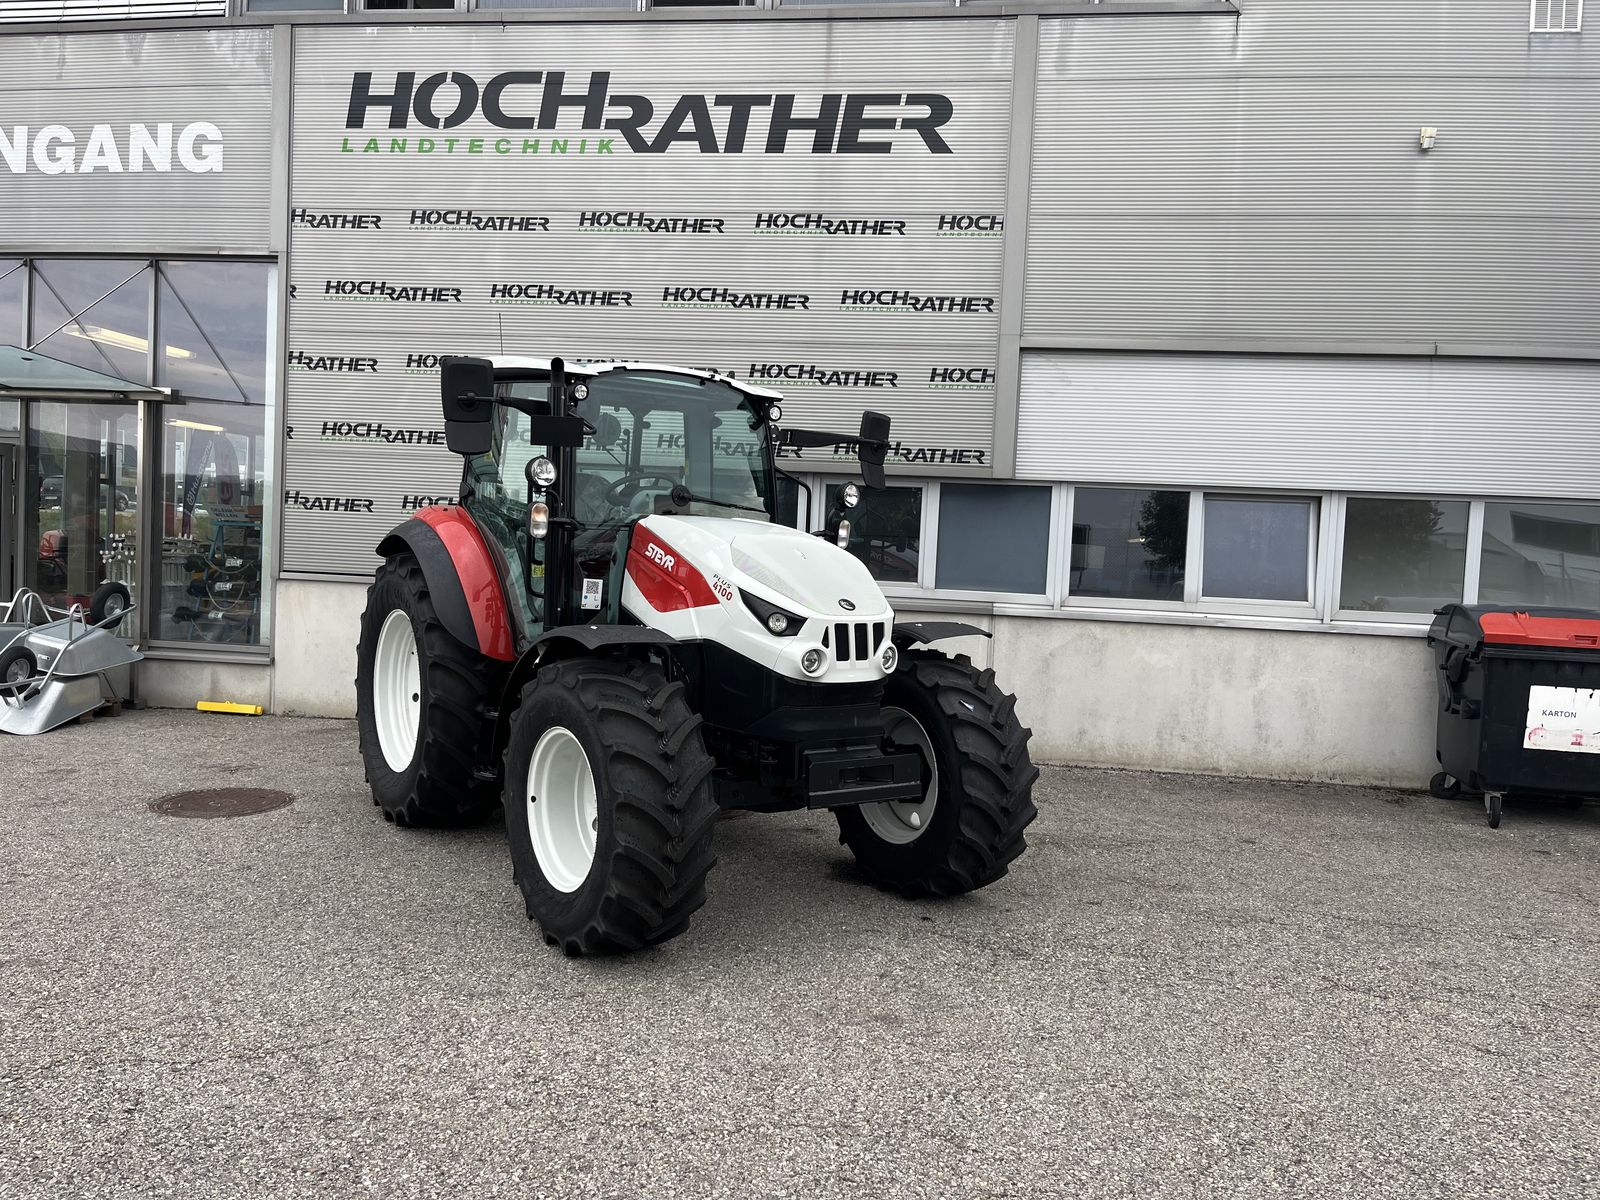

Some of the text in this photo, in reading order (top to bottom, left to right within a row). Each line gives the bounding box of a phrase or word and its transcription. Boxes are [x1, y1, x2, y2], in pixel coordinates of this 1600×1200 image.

[344, 71, 955, 154] HOCHRATHER
[0, 122, 224, 175] NGANG
[341, 138, 615, 155] LANDTECHNIK
[410, 210, 550, 231] HOCHRATHER
[579, 212, 725, 233] HOCHRATHER
[755, 213, 906, 235] HOCHRATHER
[325, 280, 462, 302] HOCHRATHER
[490, 284, 633, 306] HOCHRATHER
[662, 287, 810, 309] HOCHRATHER
[840, 290, 994, 312] HOCHRATHER
[748, 364, 898, 387] HOCHRATHER
[321, 422, 446, 445] HOCHRATHE
[644, 542, 675, 572] STEYR
[712, 581, 733, 601] 4100
[713, 573, 732, 589] PLUS
[1541, 709, 1577, 719] KARTON
